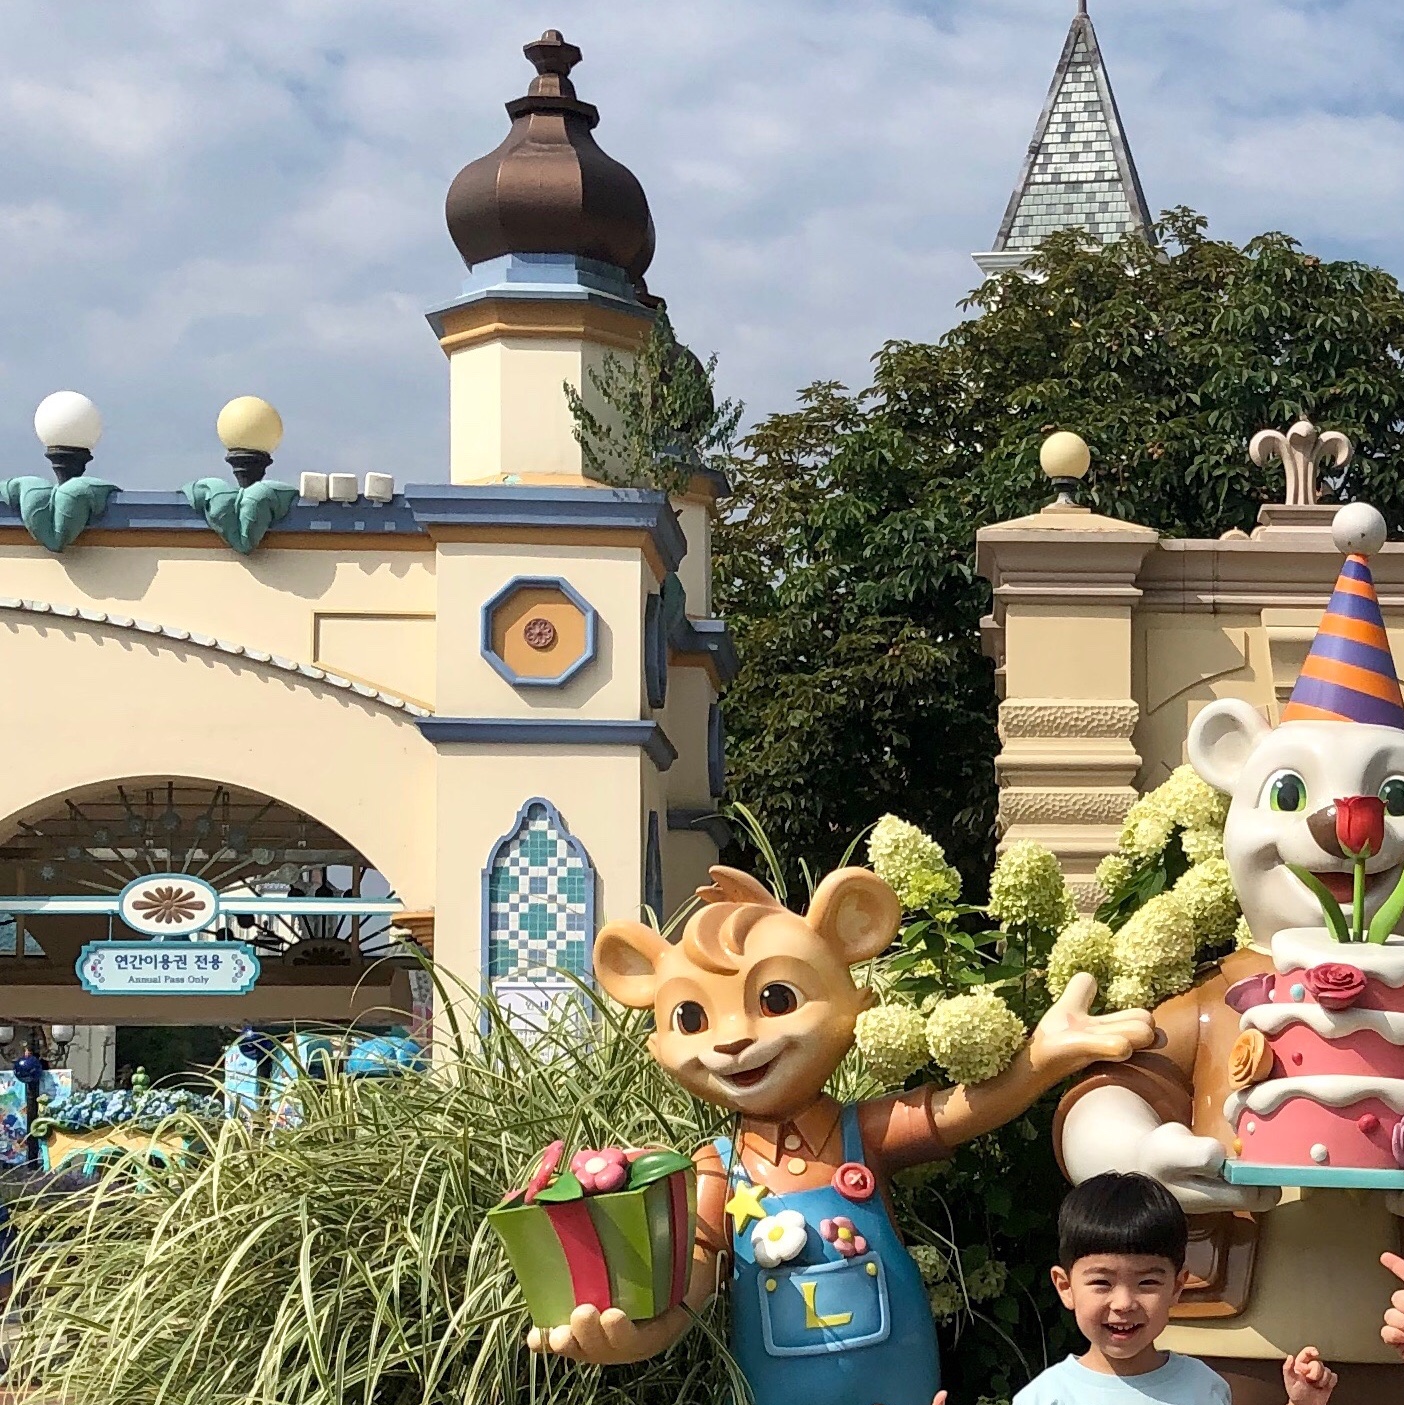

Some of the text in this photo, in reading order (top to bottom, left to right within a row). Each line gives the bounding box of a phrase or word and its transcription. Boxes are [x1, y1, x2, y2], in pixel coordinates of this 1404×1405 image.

[114, 954, 223, 970] 연간이용권 전용
[128, 975, 210, 985] Annual Pass Only
[800, 1281, 854, 1329] L
